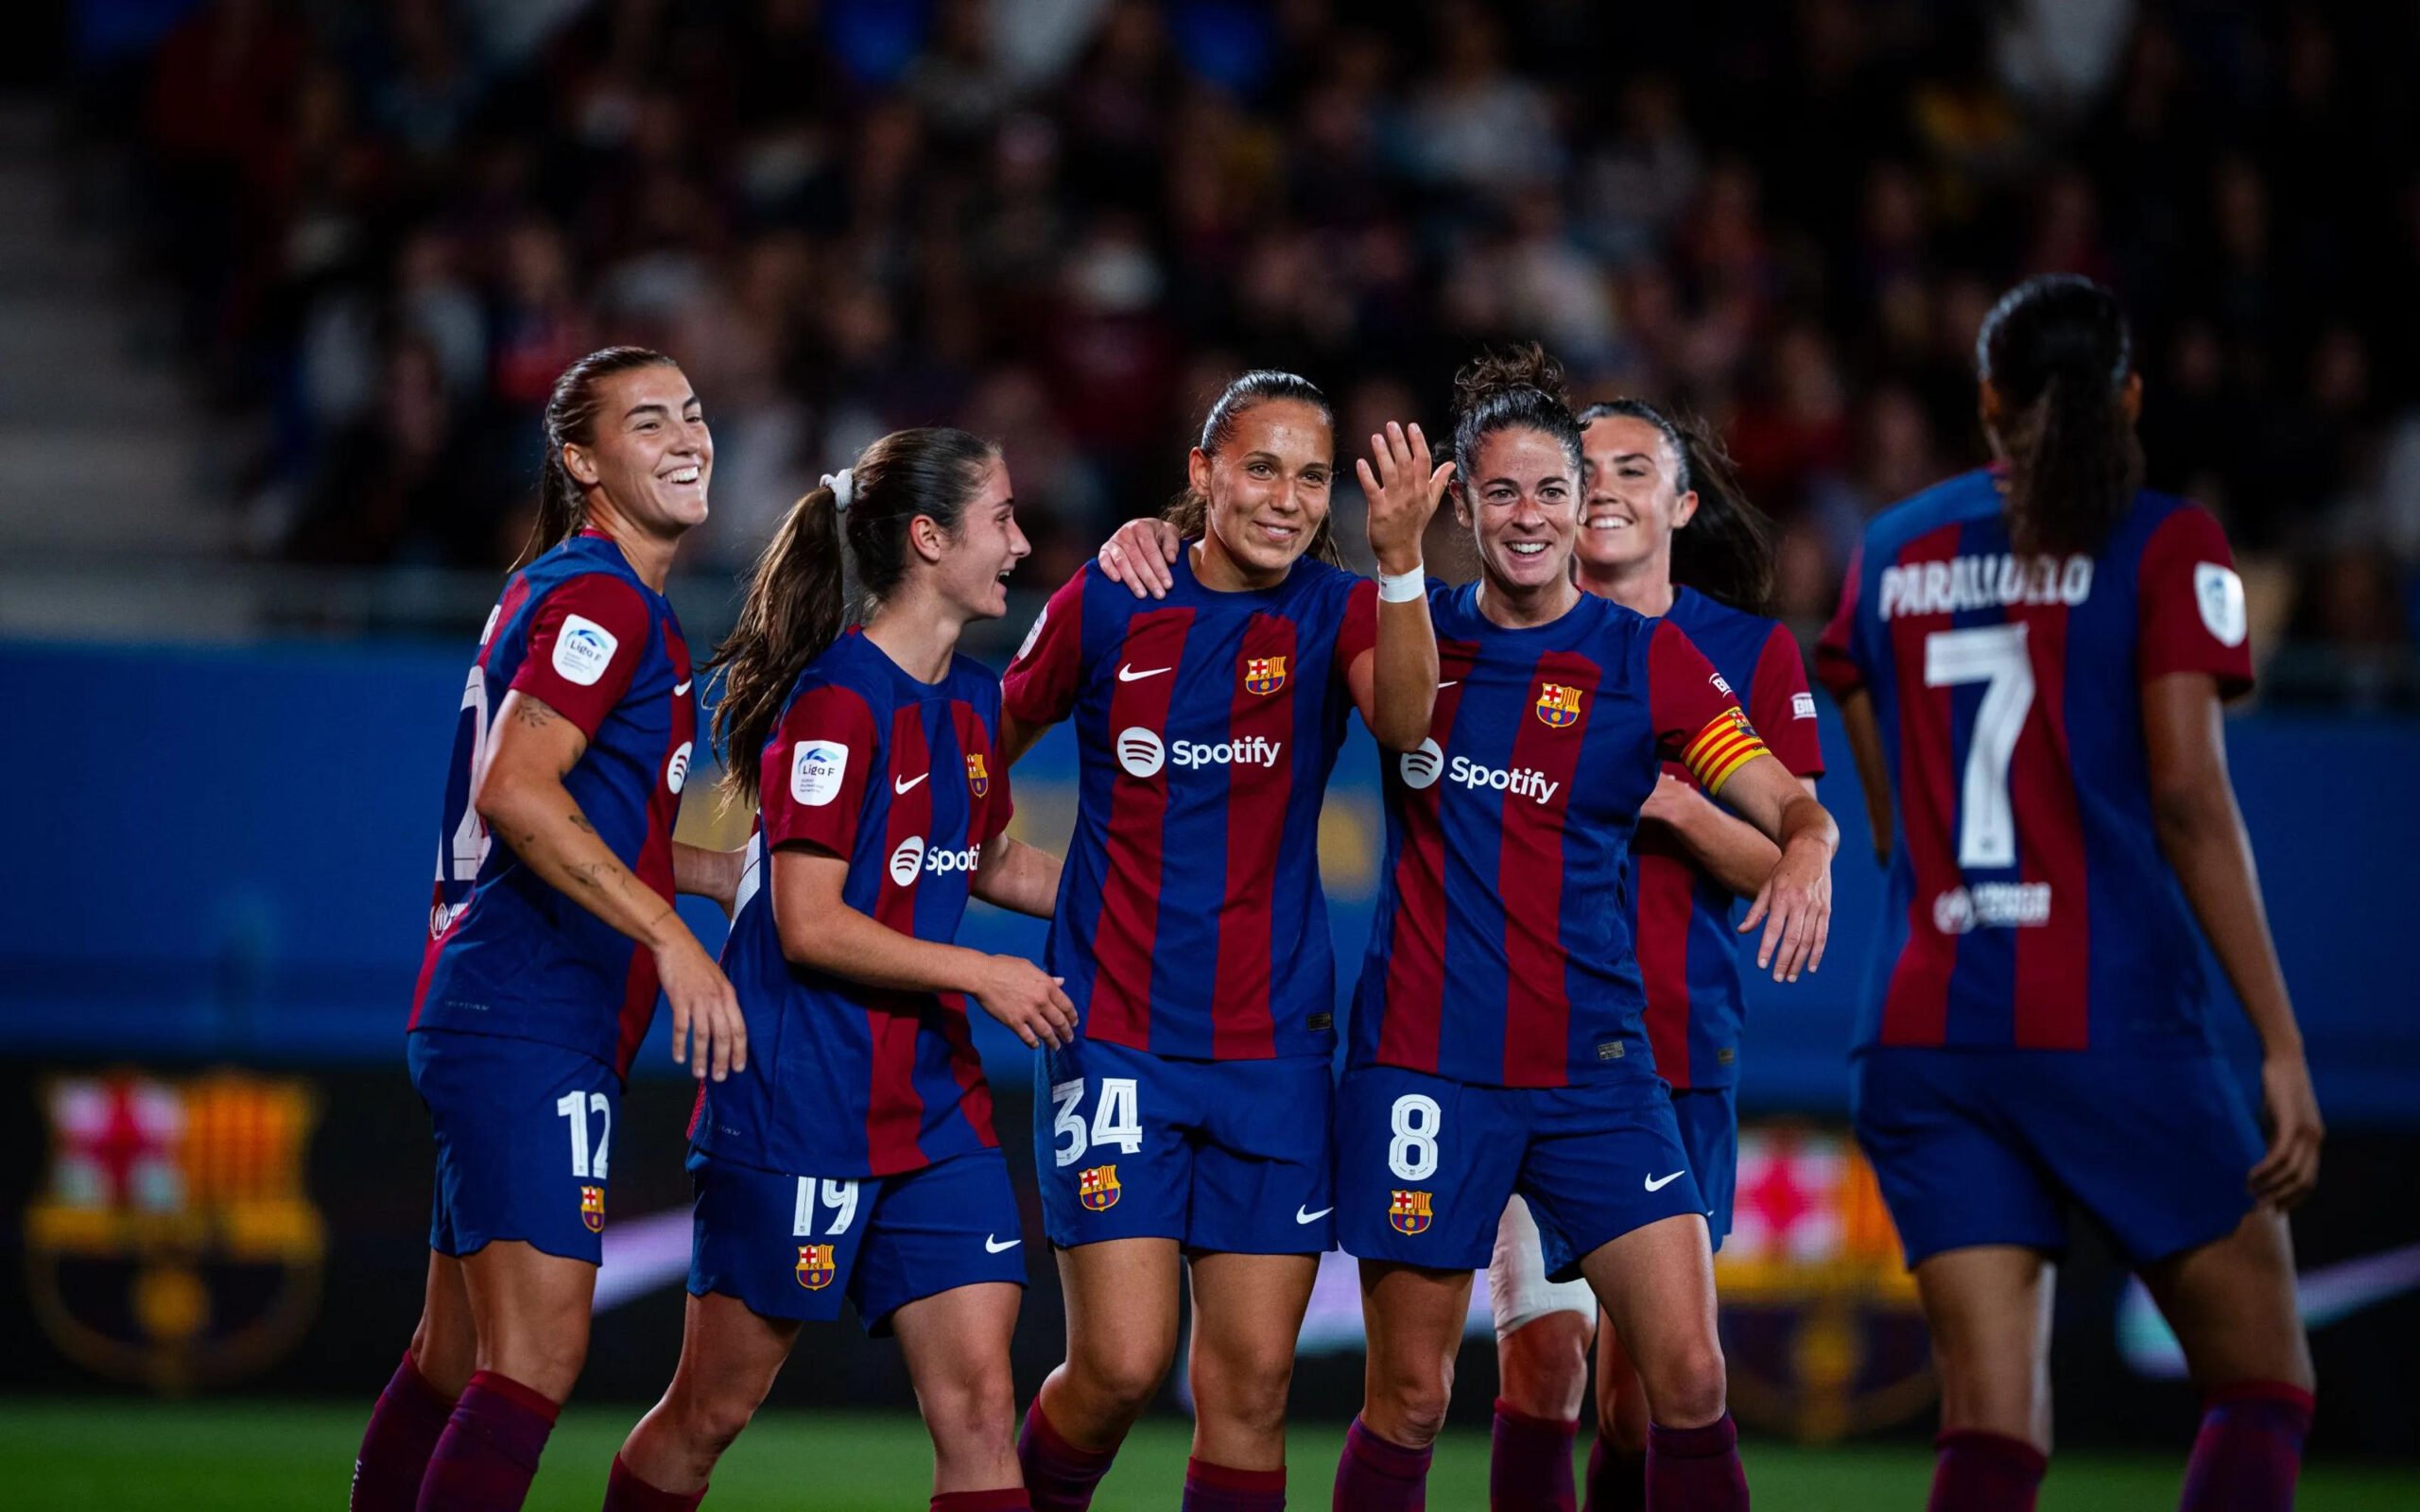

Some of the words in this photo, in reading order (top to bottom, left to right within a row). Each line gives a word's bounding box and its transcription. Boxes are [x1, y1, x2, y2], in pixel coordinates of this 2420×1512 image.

[570, 640, 594, 658] Liga
[803, 764, 825, 776] Liga
[827, 767, 835, 776] F
[1172, 735, 1281, 770] Spotify
[1925, 620, 2035, 868] 7
[1448, 755, 1559, 804] Spotify
[557, 1091, 612, 1180] 12
[1052, 1076, 1143, 1167] 34
[1388, 1093, 1442, 1181] 8
[792, 1176, 859, 1237] 19
